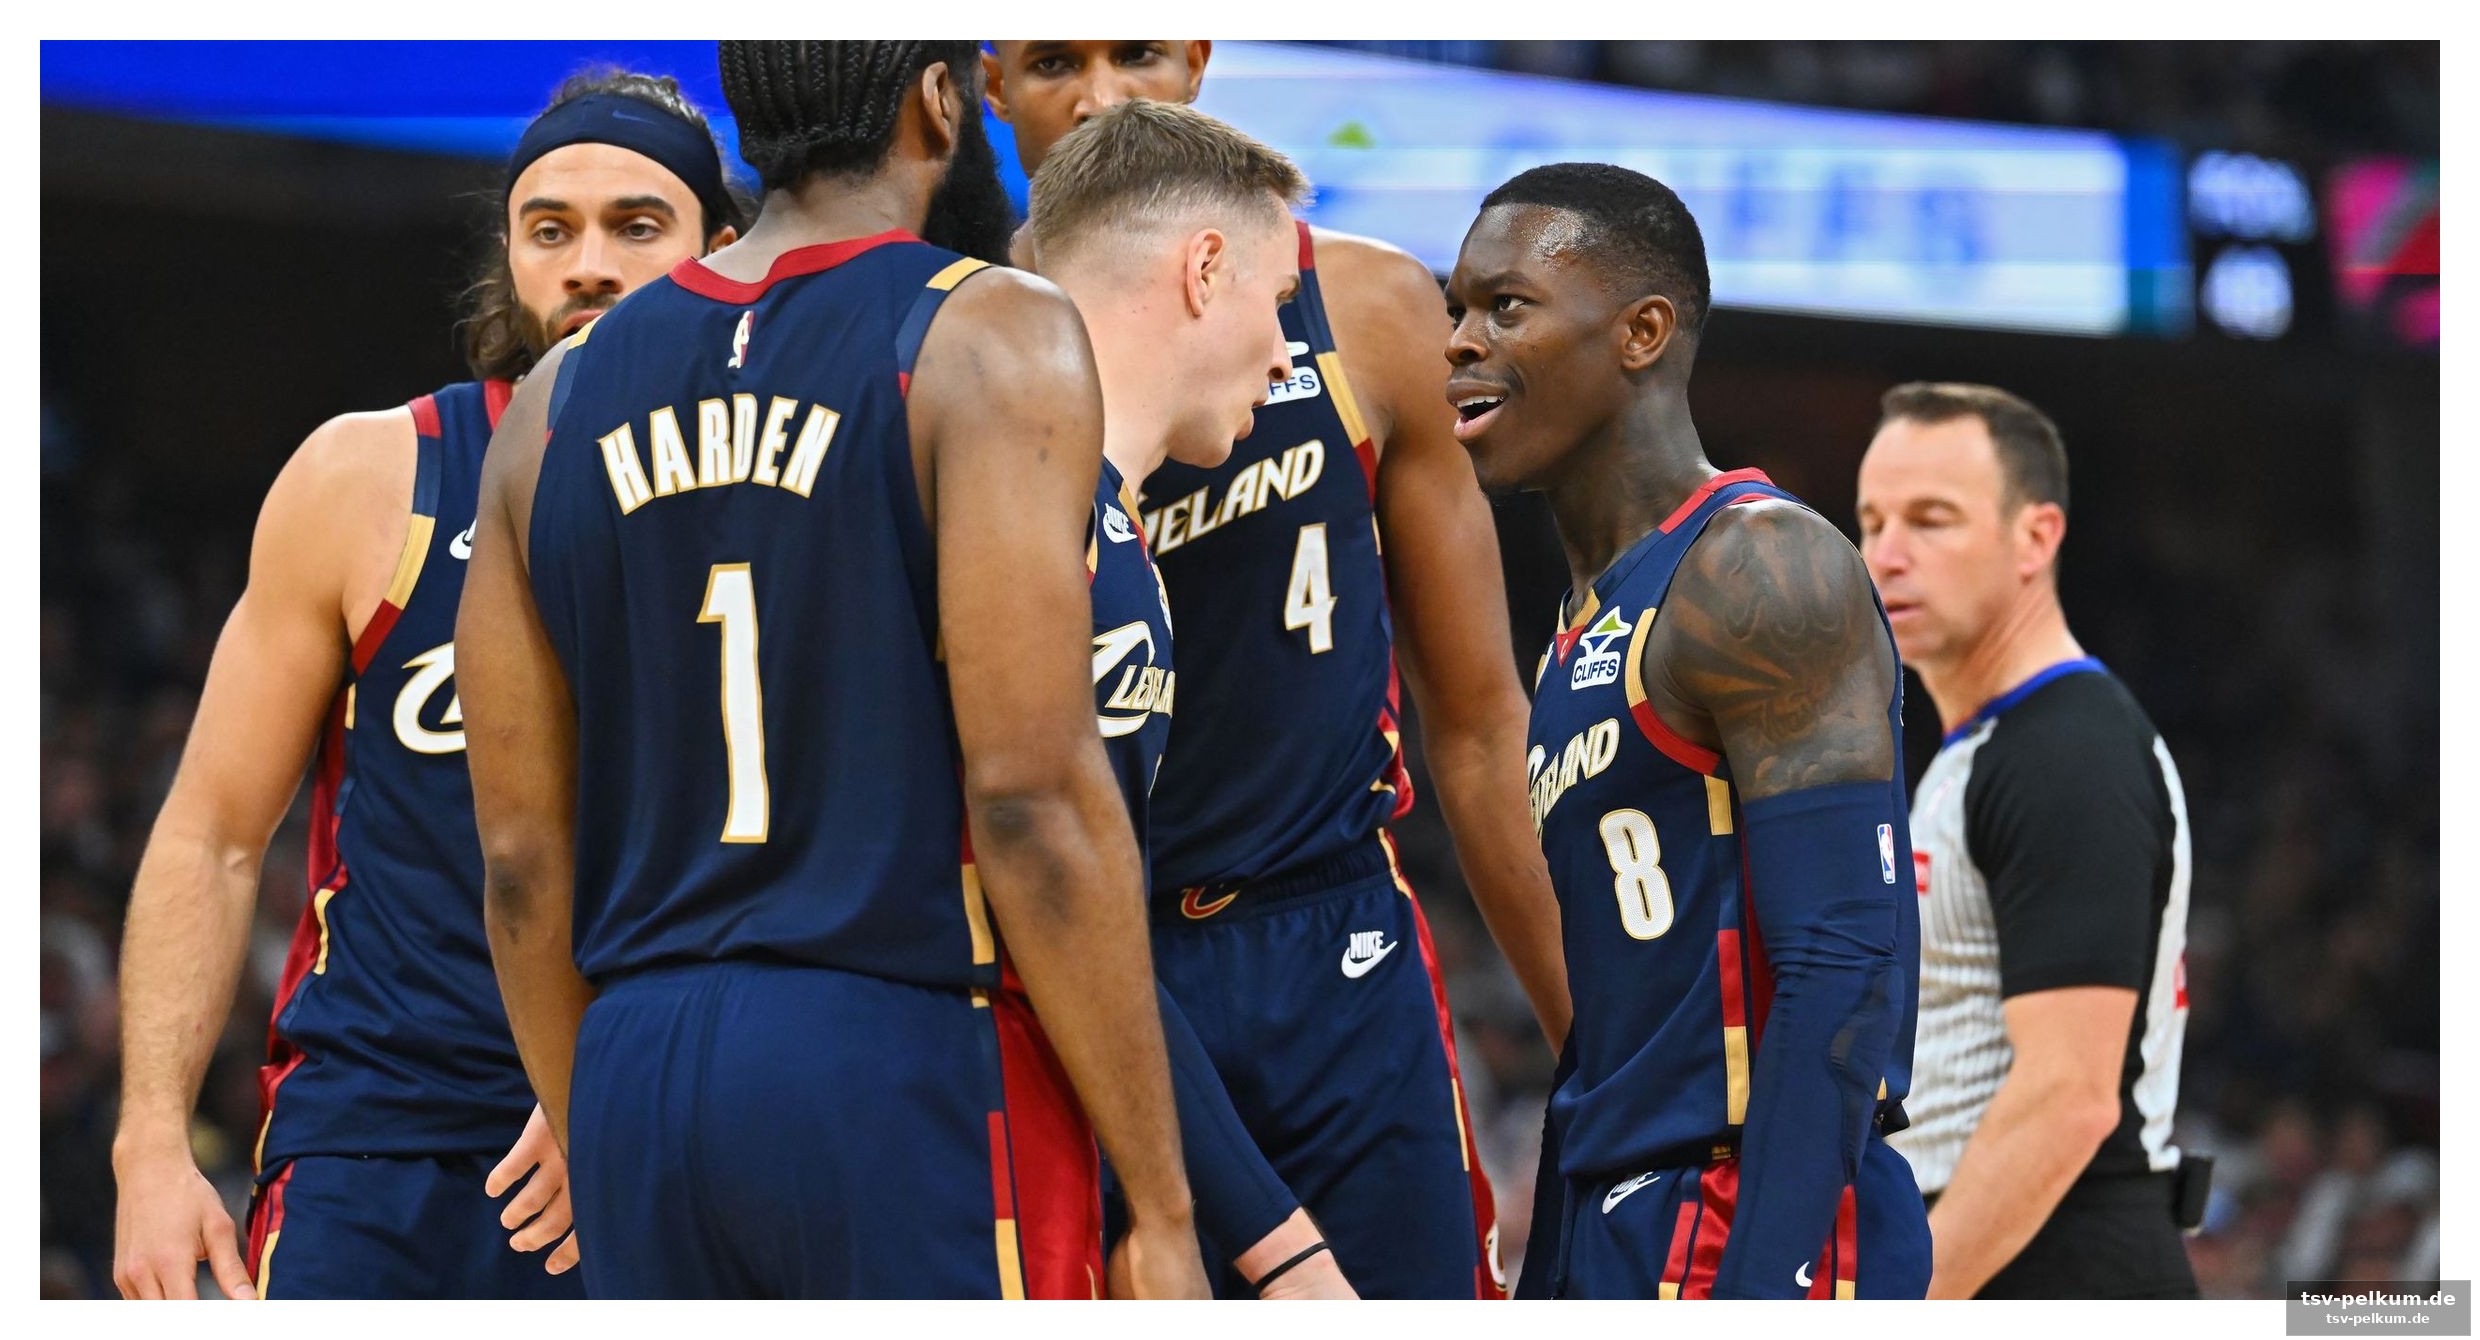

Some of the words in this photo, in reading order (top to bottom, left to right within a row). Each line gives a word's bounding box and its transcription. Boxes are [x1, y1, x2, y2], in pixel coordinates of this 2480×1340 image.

[1268, 374, 1316, 396] FFS
[599, 393, 840, 515] HARDEN
[1284, 522, 1338, 654] 4
[696, 562, 769, 843] 1
[1574, 658, 1617, 683] CLIFFS
[1599, 808, 1674, 941] 8
[1350, 930, 1384, 959] NIKE
